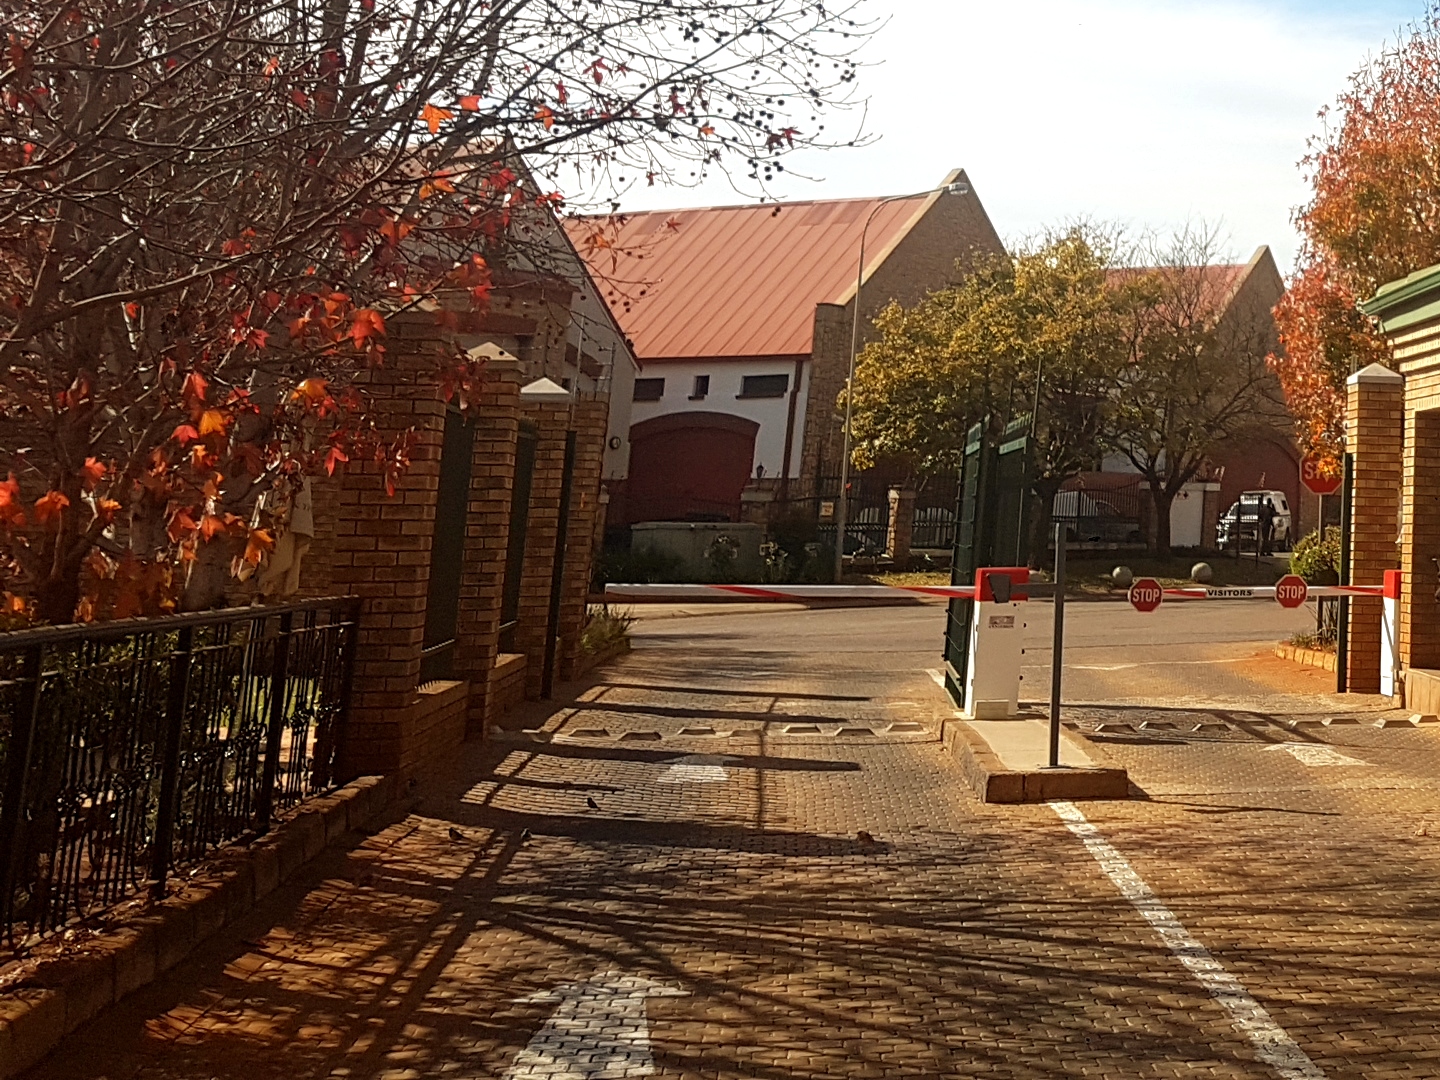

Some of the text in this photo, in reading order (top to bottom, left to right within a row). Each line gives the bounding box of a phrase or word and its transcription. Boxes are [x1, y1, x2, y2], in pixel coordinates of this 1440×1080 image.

[1132, 588, 1160, 602] STOP
[1207, 589, 1252, 597] VISITORS
[1278, 585, 1304, 599] STOP
